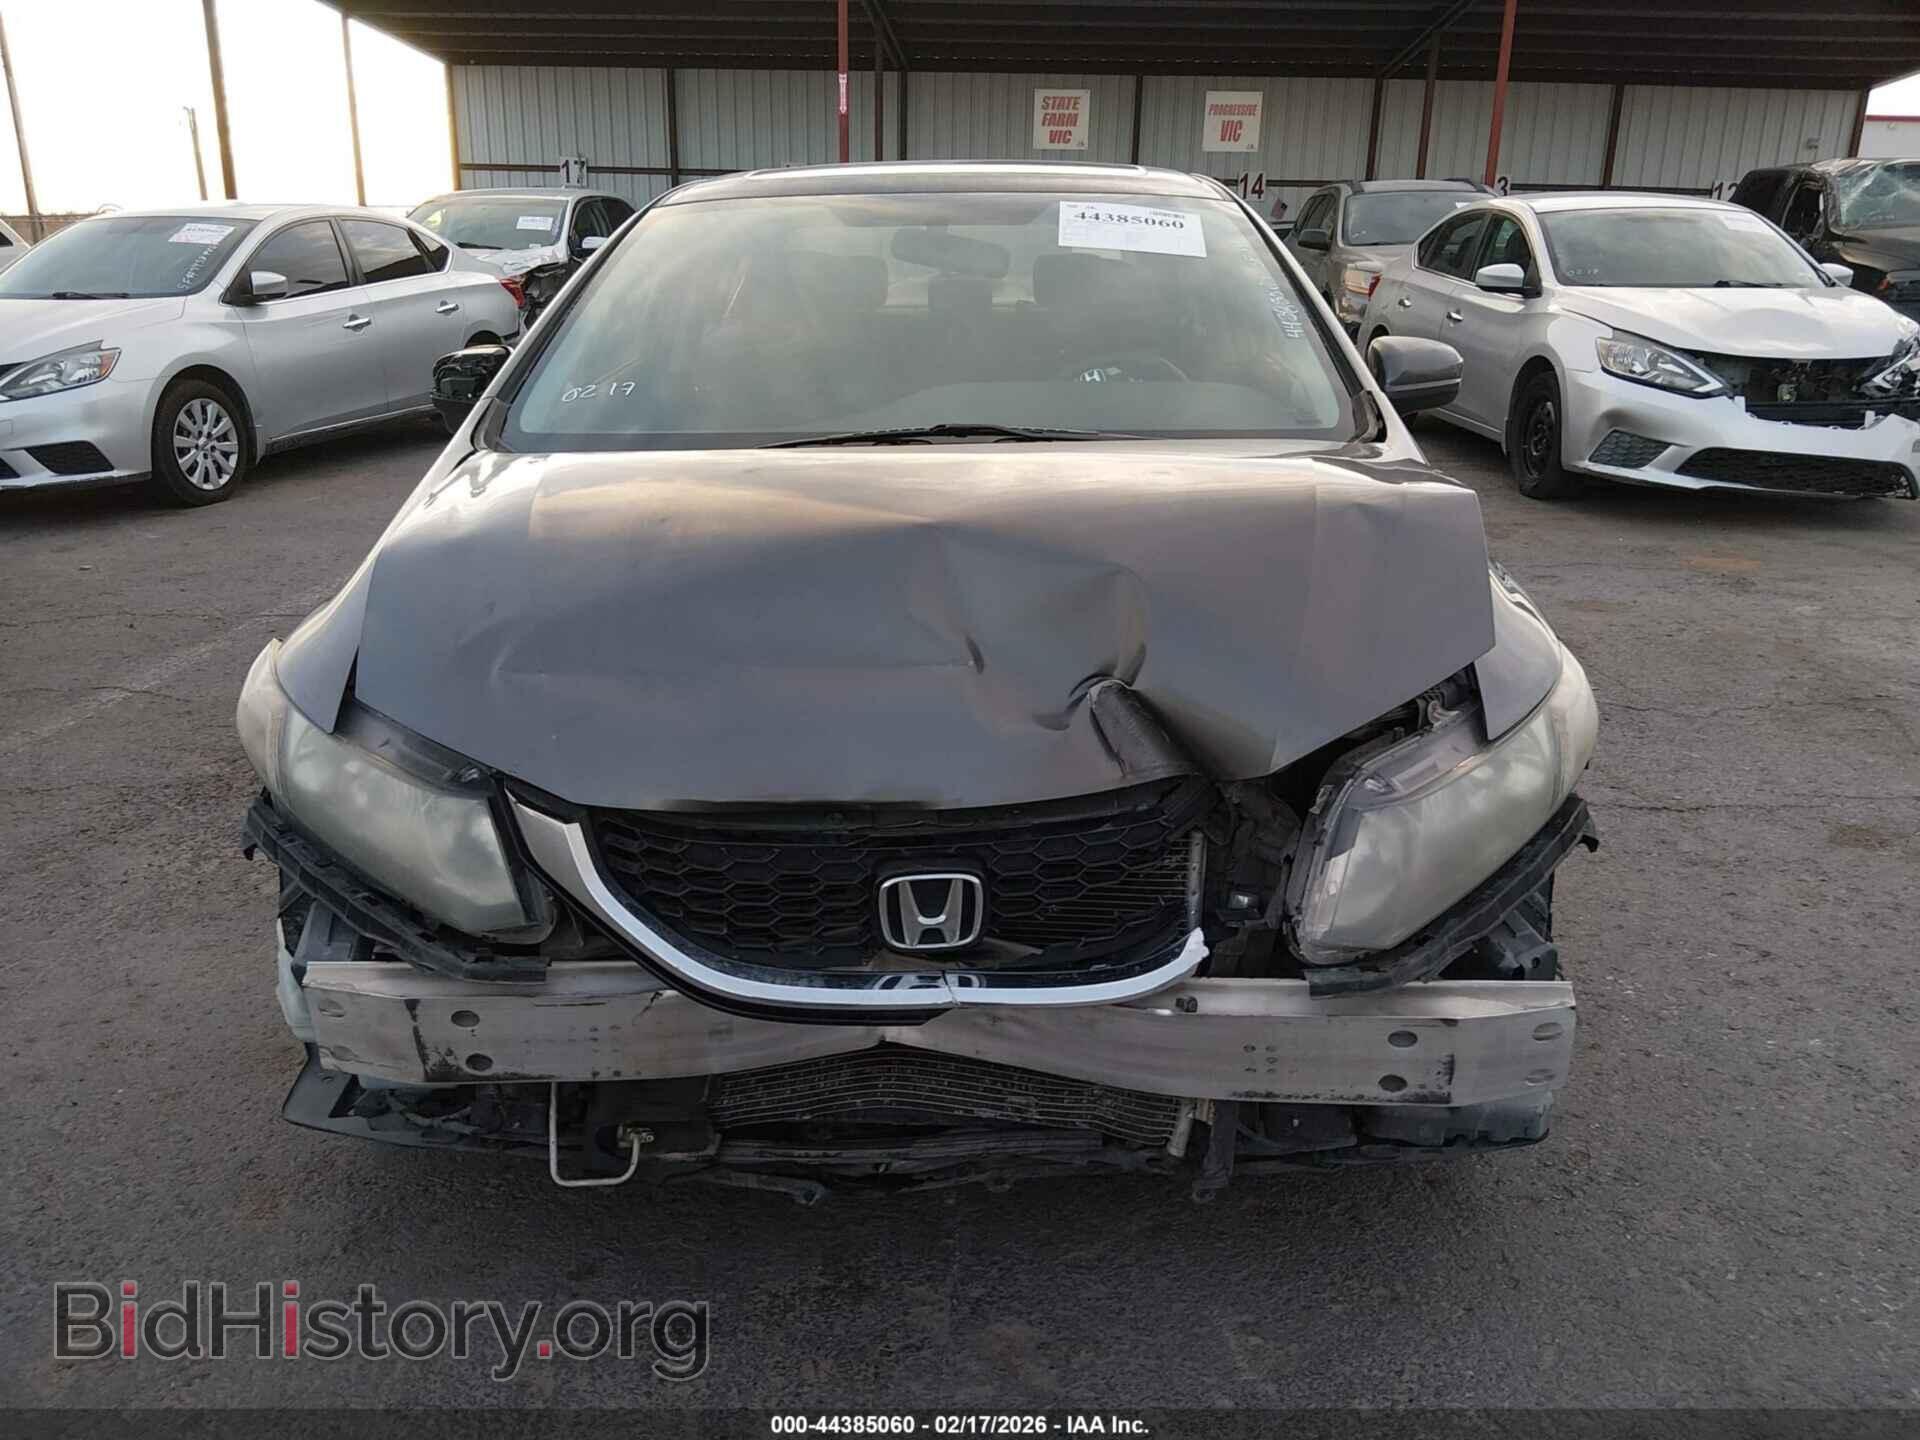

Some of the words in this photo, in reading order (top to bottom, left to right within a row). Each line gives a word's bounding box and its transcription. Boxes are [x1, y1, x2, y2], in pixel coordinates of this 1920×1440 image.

[1041, 95, 1080, 110] STATE
[1208, 103, 1258, 116] PROGRESSIVE
[1041, 112, 1079, 127] FARM
[1049, 129, 1072, 144] VIC
[1220, 119, 1243, 142] VIC
[1240, 173, 1264, 199] 14
[1074, 211, 1185, 229] 44385060
[561, 384, 597, 402] 02
[609, 381, 636, 396] 17
